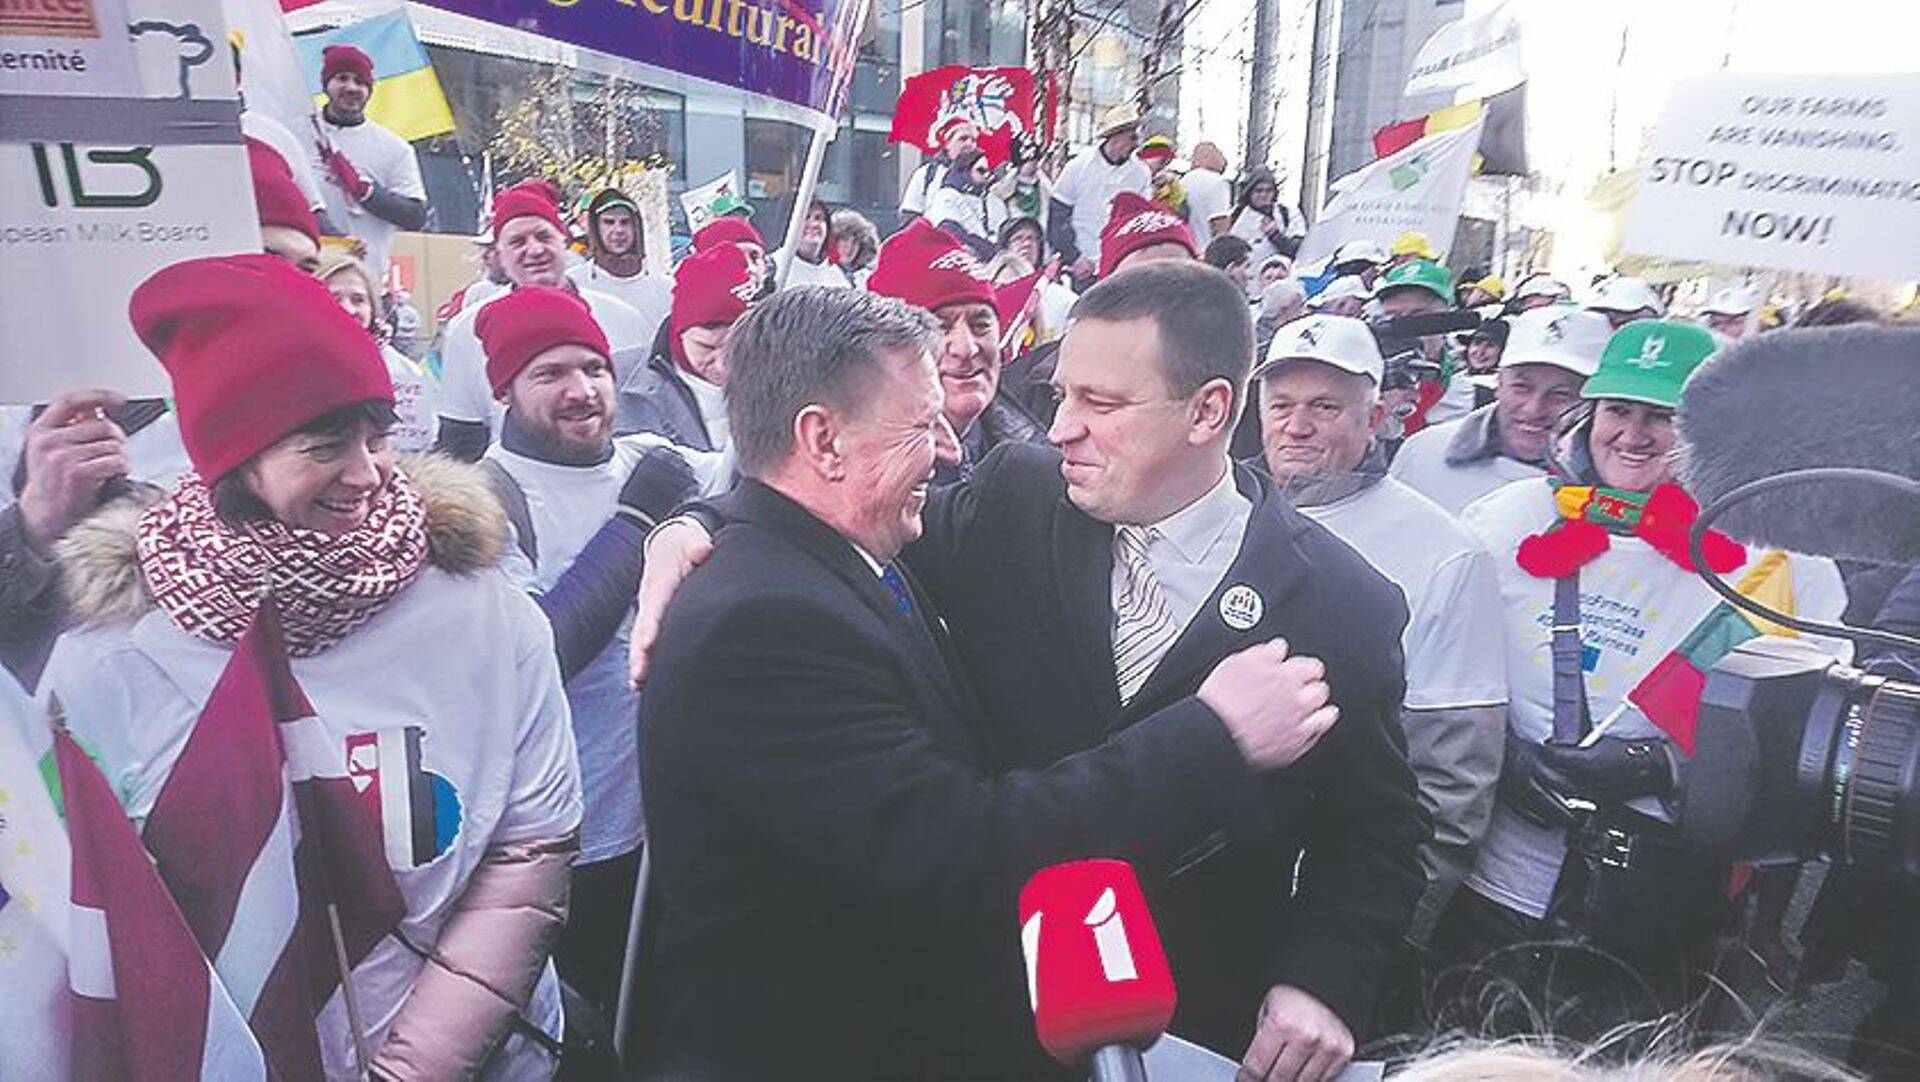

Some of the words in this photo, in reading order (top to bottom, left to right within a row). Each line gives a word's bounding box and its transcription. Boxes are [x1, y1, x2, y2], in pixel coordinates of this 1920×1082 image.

[0, 48, 87, 72] ernité
[1742, 95, 1796, 115] OUR
[1798, 96, 1887, 118] FARMS
[1708, 125, 1755, 144] ARE
[1650, 156, 1737, 186] STOP
[0, 225, 71, 247] pean
[76, 222, 134, 243] Milk
[138, 222, 210, 243] Board
[1721, 209, 1835, 246] NOW!
